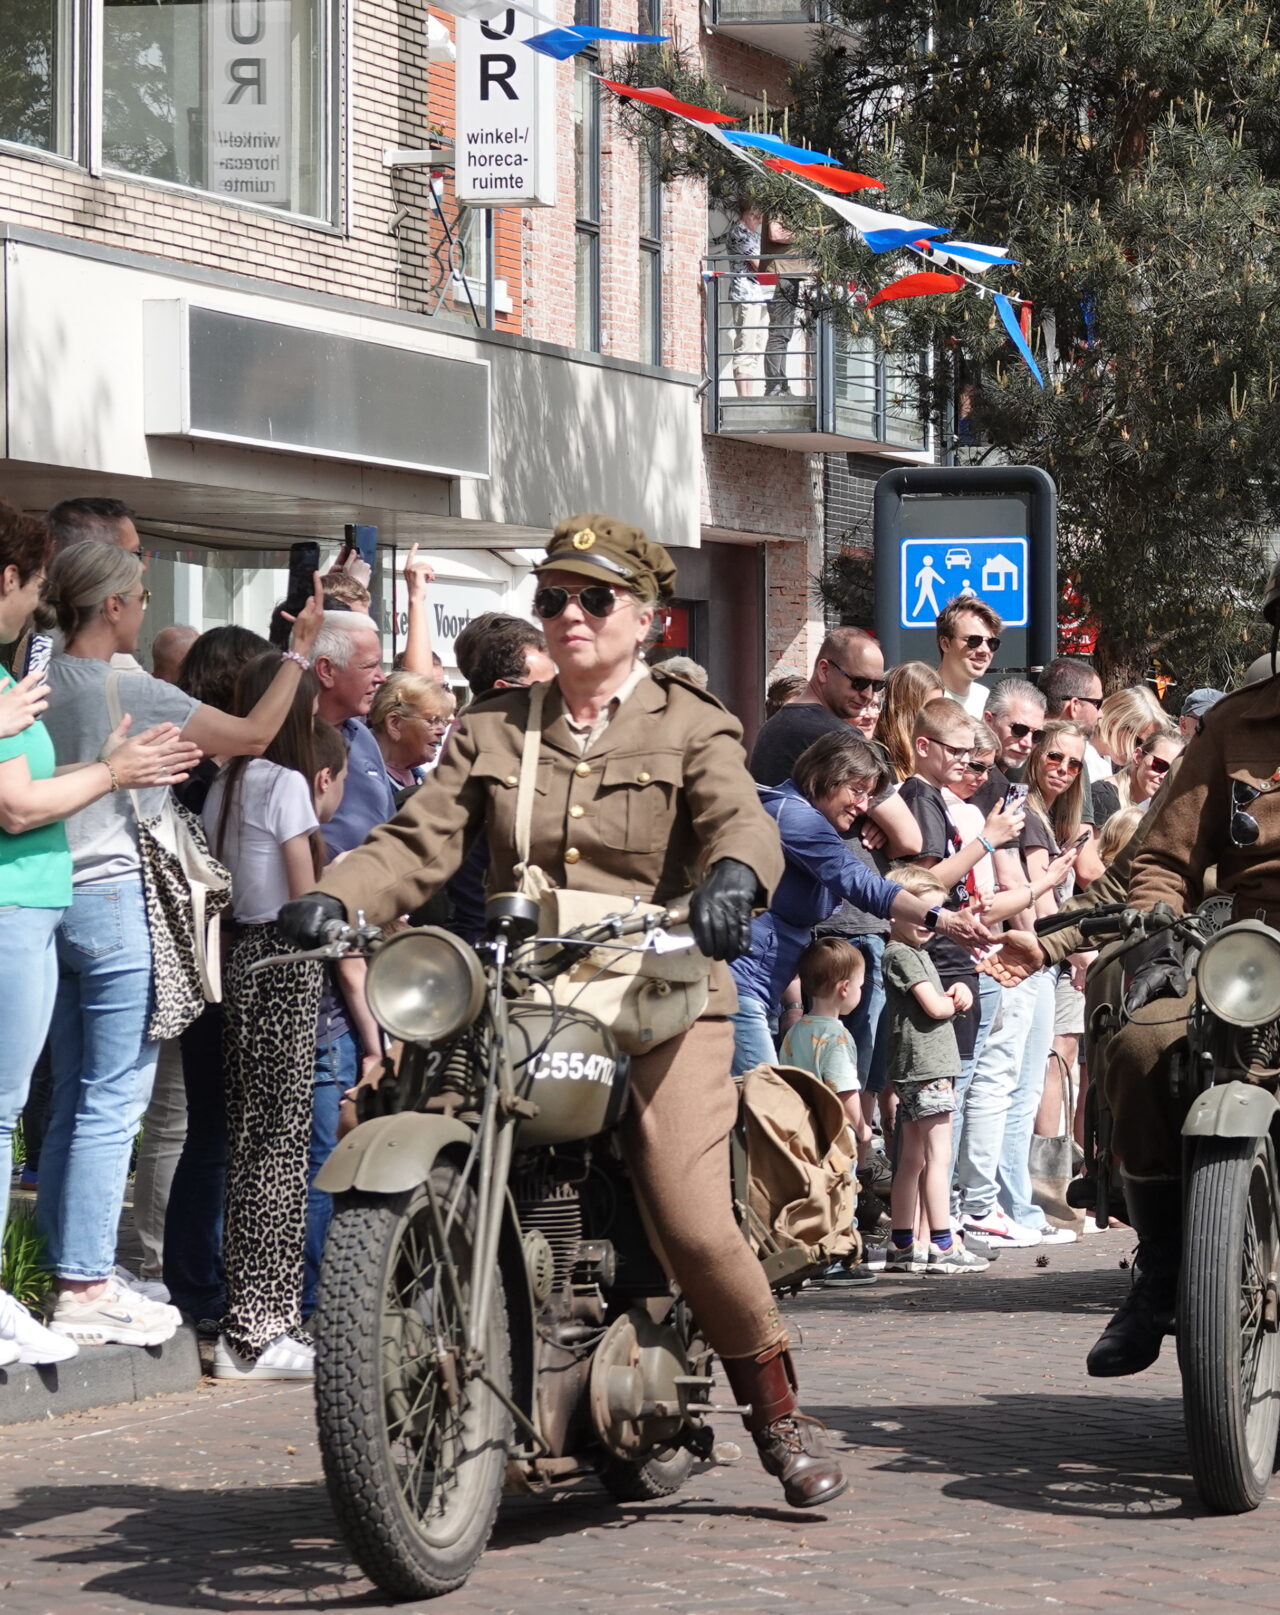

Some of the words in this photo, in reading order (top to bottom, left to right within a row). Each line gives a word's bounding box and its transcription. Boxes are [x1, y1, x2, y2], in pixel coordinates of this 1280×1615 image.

[466, 127, 529, 145] winkel-/
[467, 151, 529, 167] horeca-
[472, 173, 524, 190] ruimte
[426, 1051, 442, 1077] 2
